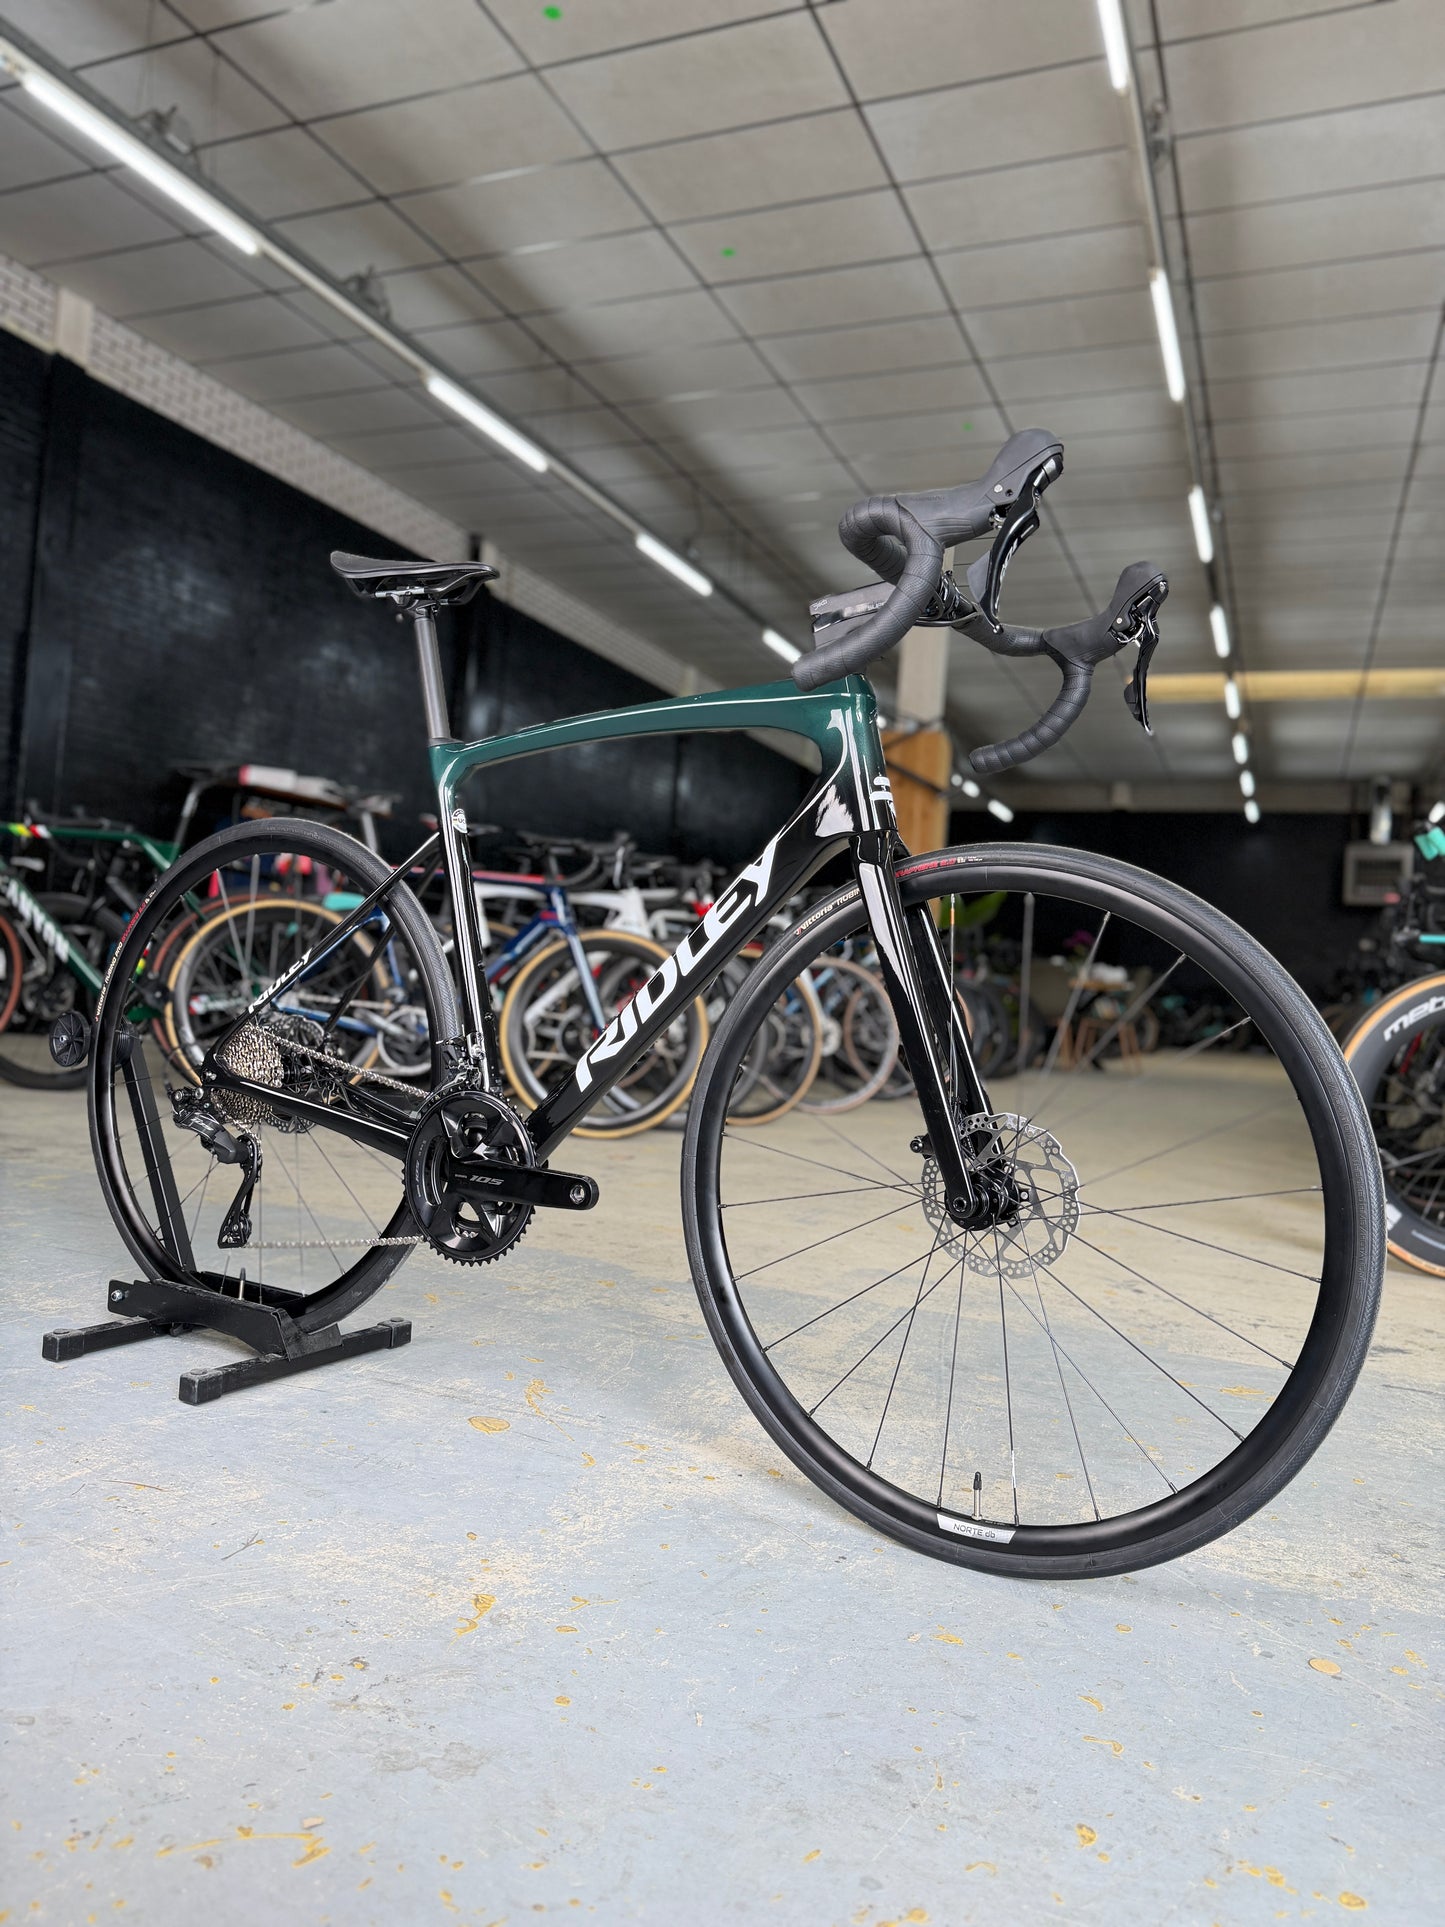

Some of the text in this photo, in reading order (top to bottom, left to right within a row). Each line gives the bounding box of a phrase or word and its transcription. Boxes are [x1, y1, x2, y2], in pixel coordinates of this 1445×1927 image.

[801, 903, 834, 930] Vittoria
[576, 830, 780, 1092] RIDLEY
[248, 947, 313, 1014] RIDLEY
[469, 1174, 505, 1186] 105
[953, 1523, 984, 1536] NORTE
[985, 1530, 996, 1539] db
